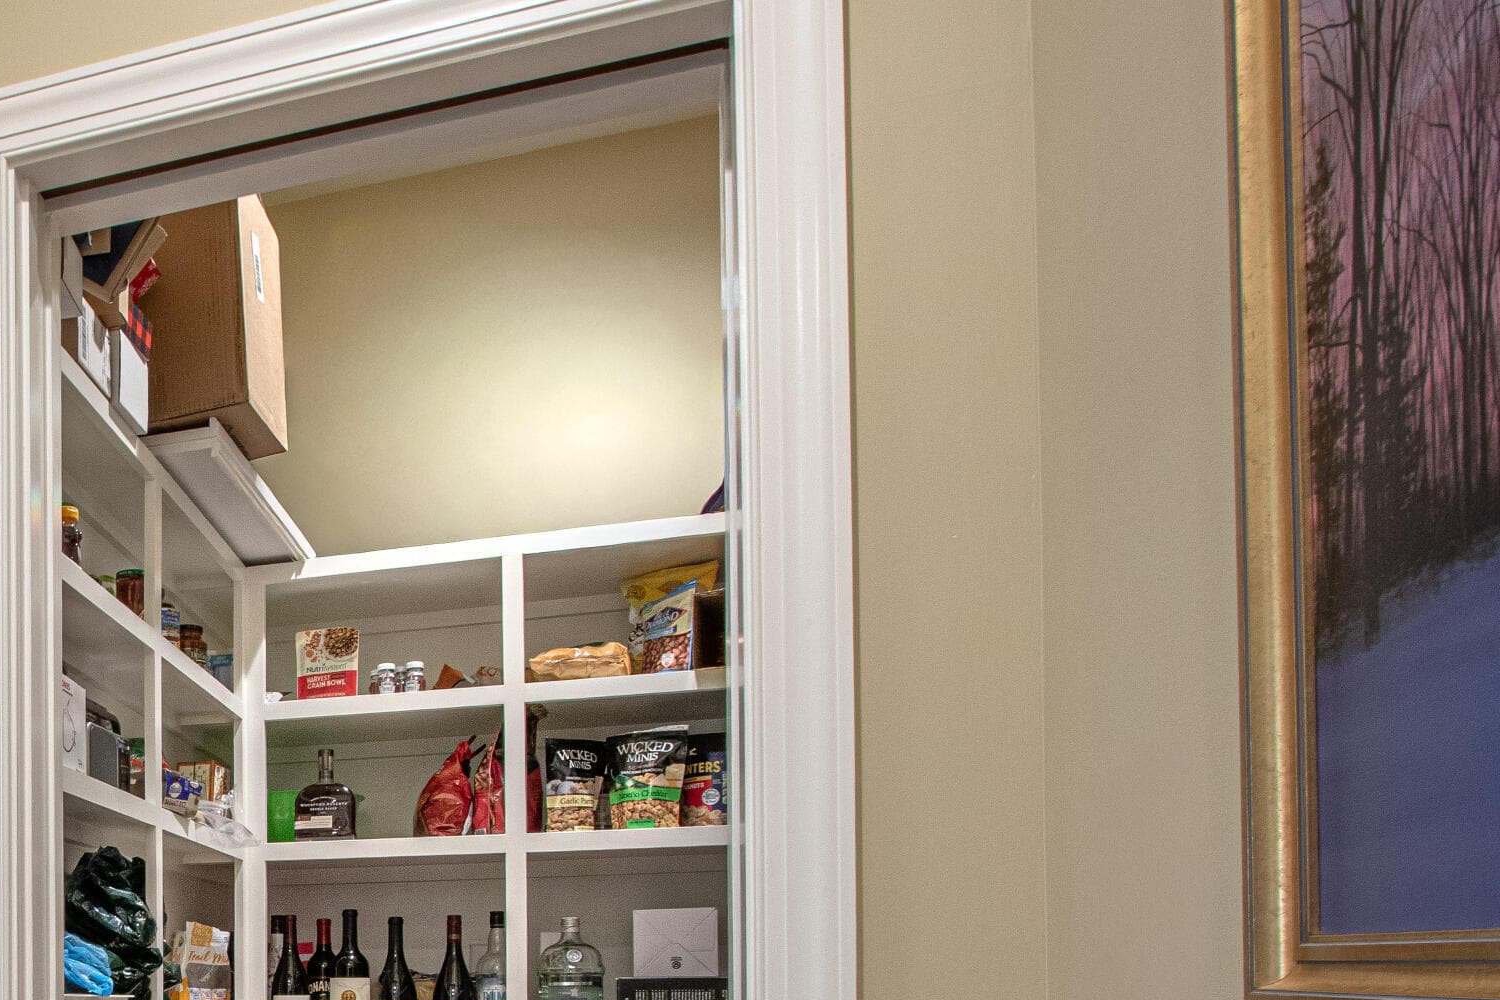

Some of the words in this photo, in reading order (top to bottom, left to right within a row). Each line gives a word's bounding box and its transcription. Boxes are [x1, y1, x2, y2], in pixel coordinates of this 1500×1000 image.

[306, 675, 331, 683] HARVEST
[307, 681, 326, 690] GRAIN
[326, 678, 347, 687] BOWL
[615, 741, 674, 756] WICKED
[556, 749, 598, 763] WICKED
[626, 752, 659, 763] MINIS
[569, 760, 592, 770] MINIS
